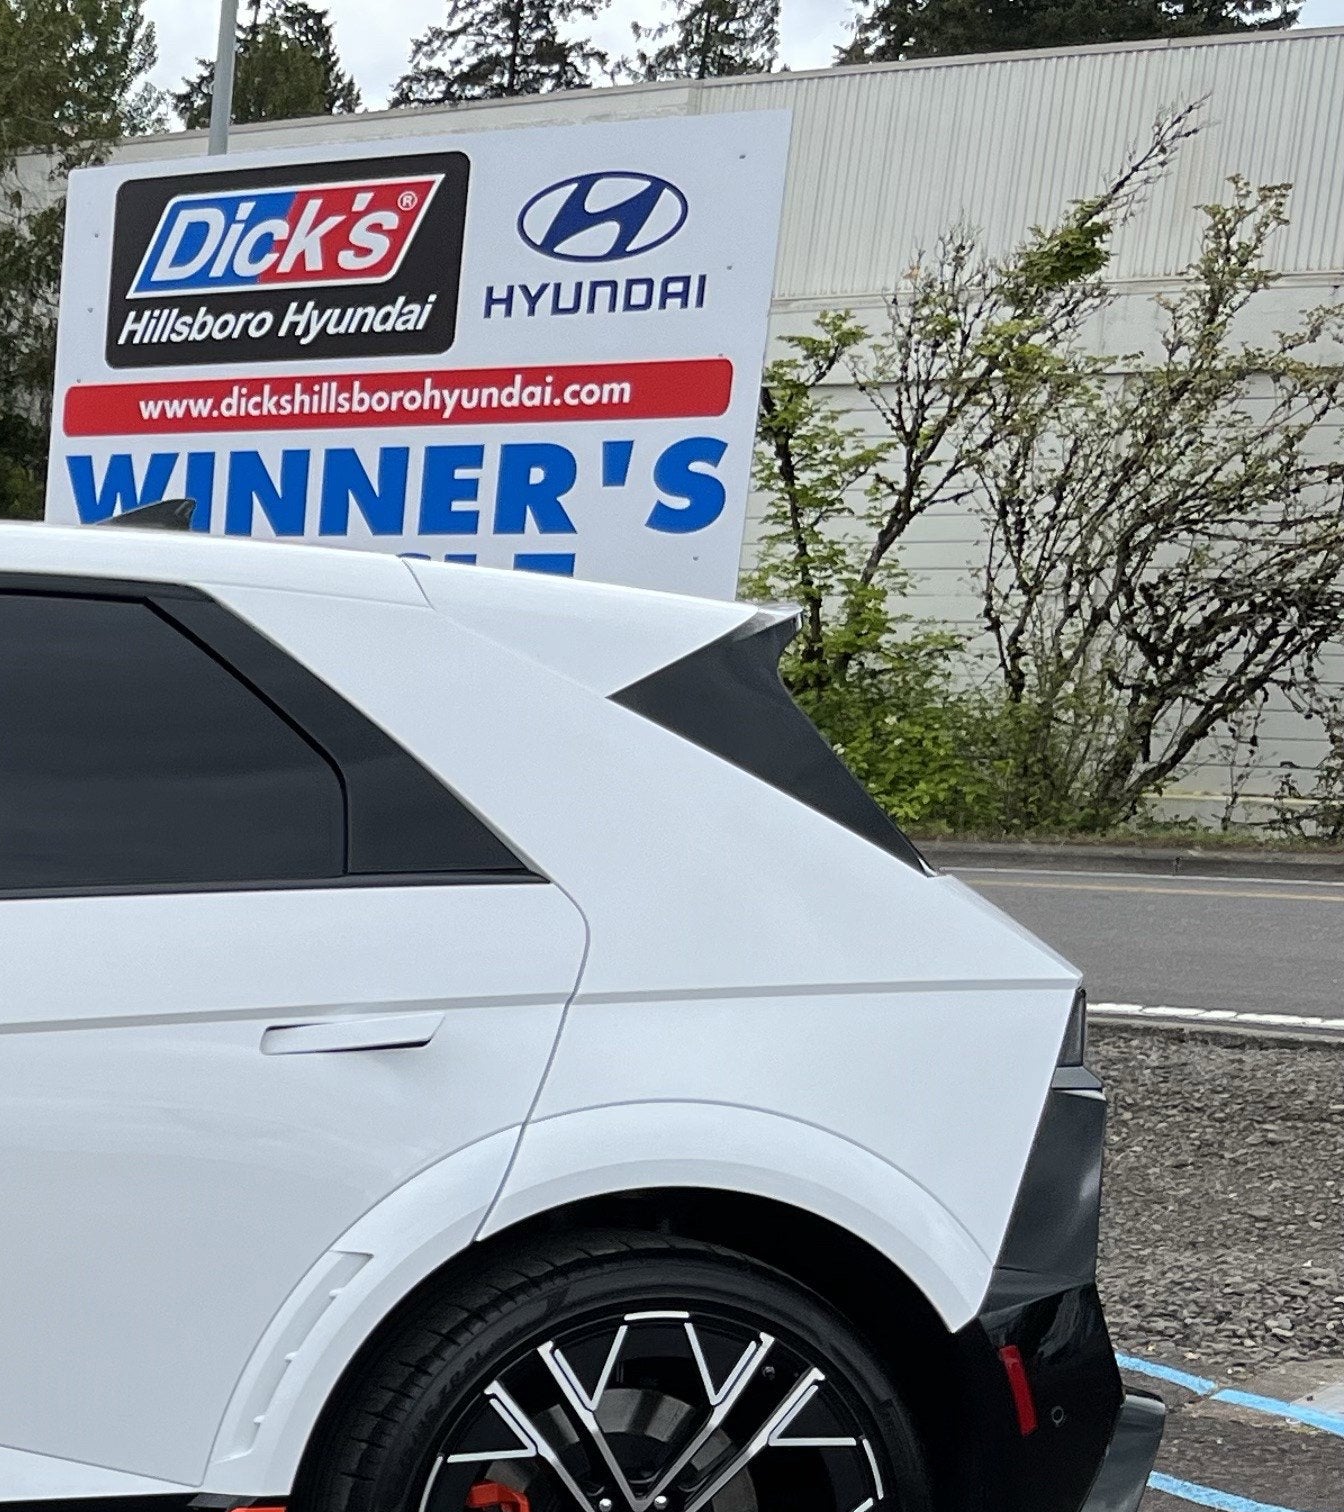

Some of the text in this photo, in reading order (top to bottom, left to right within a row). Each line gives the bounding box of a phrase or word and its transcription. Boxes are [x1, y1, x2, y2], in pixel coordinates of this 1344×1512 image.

[117, 294, 438, 346] Hillsboro Hyundai
[483, 274, 708, 319] HYUNDAI
[138, 376, 632, 422] www.dickshillsborohyundai.com
[65, 437, 728, 536] WINNER'S
